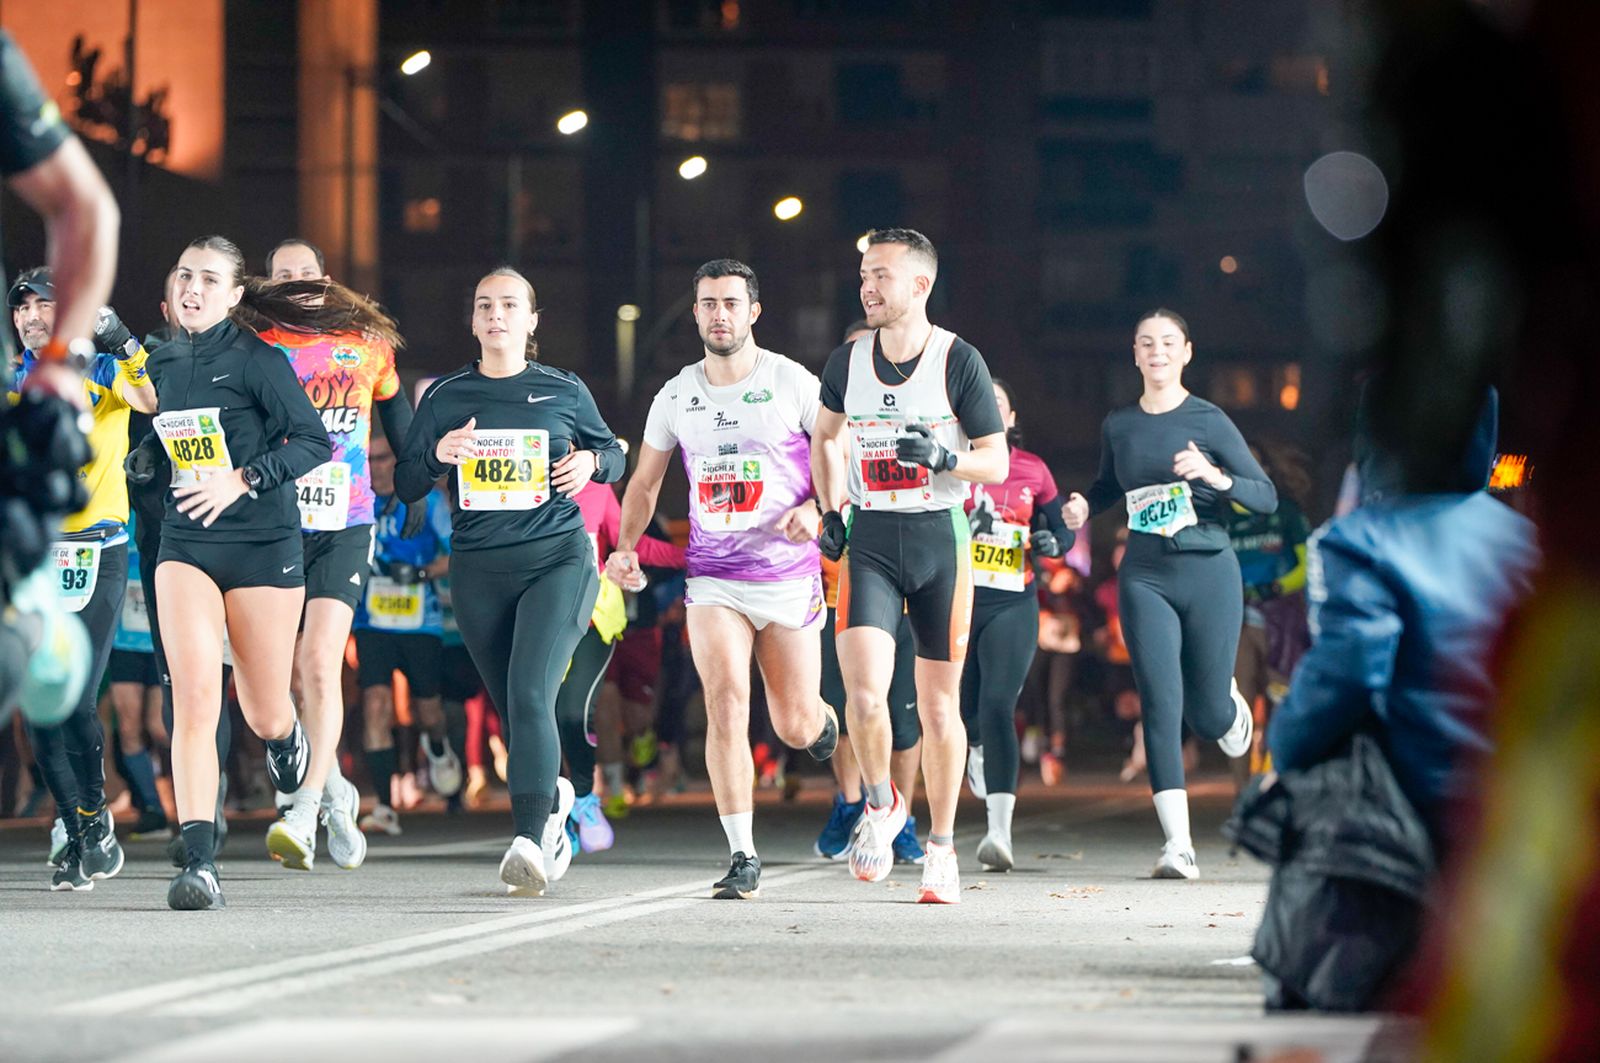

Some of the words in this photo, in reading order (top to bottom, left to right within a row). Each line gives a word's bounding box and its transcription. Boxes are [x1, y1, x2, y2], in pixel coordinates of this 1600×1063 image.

[297, 370, 354, 410] OY
[317, 406, 359, 434] ALE
[173, 437, 215, 462] 4828
[477, 439, 504, 447] NOCHE
[505, 439, 515, 447] DE
[866, 440, 889, 448] NOCHE
[874, 449, 896, 457] ANTÓ
[474, 459, 532, 482] 4829
[868, 460, 918, 482] 4830
[974, 544, 1014, 567] 5743
